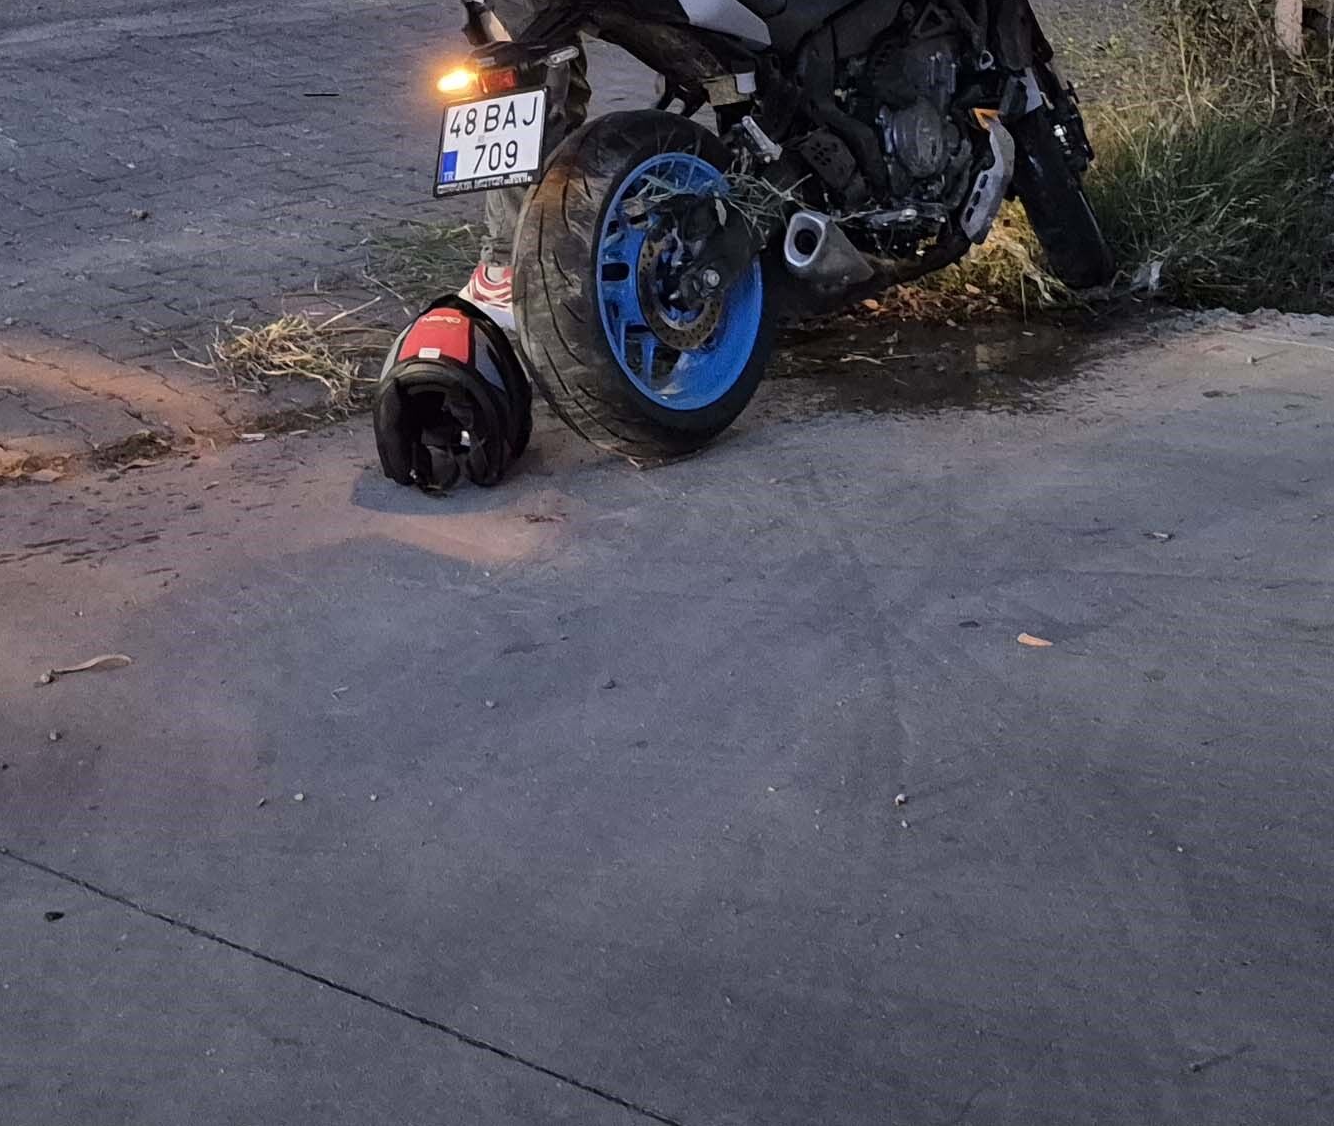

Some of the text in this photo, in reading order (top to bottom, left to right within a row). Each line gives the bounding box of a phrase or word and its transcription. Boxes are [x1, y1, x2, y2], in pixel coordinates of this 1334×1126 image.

[450, 96, 539, 139] 48 BAJ
[472, 139, 519, 175] 709
